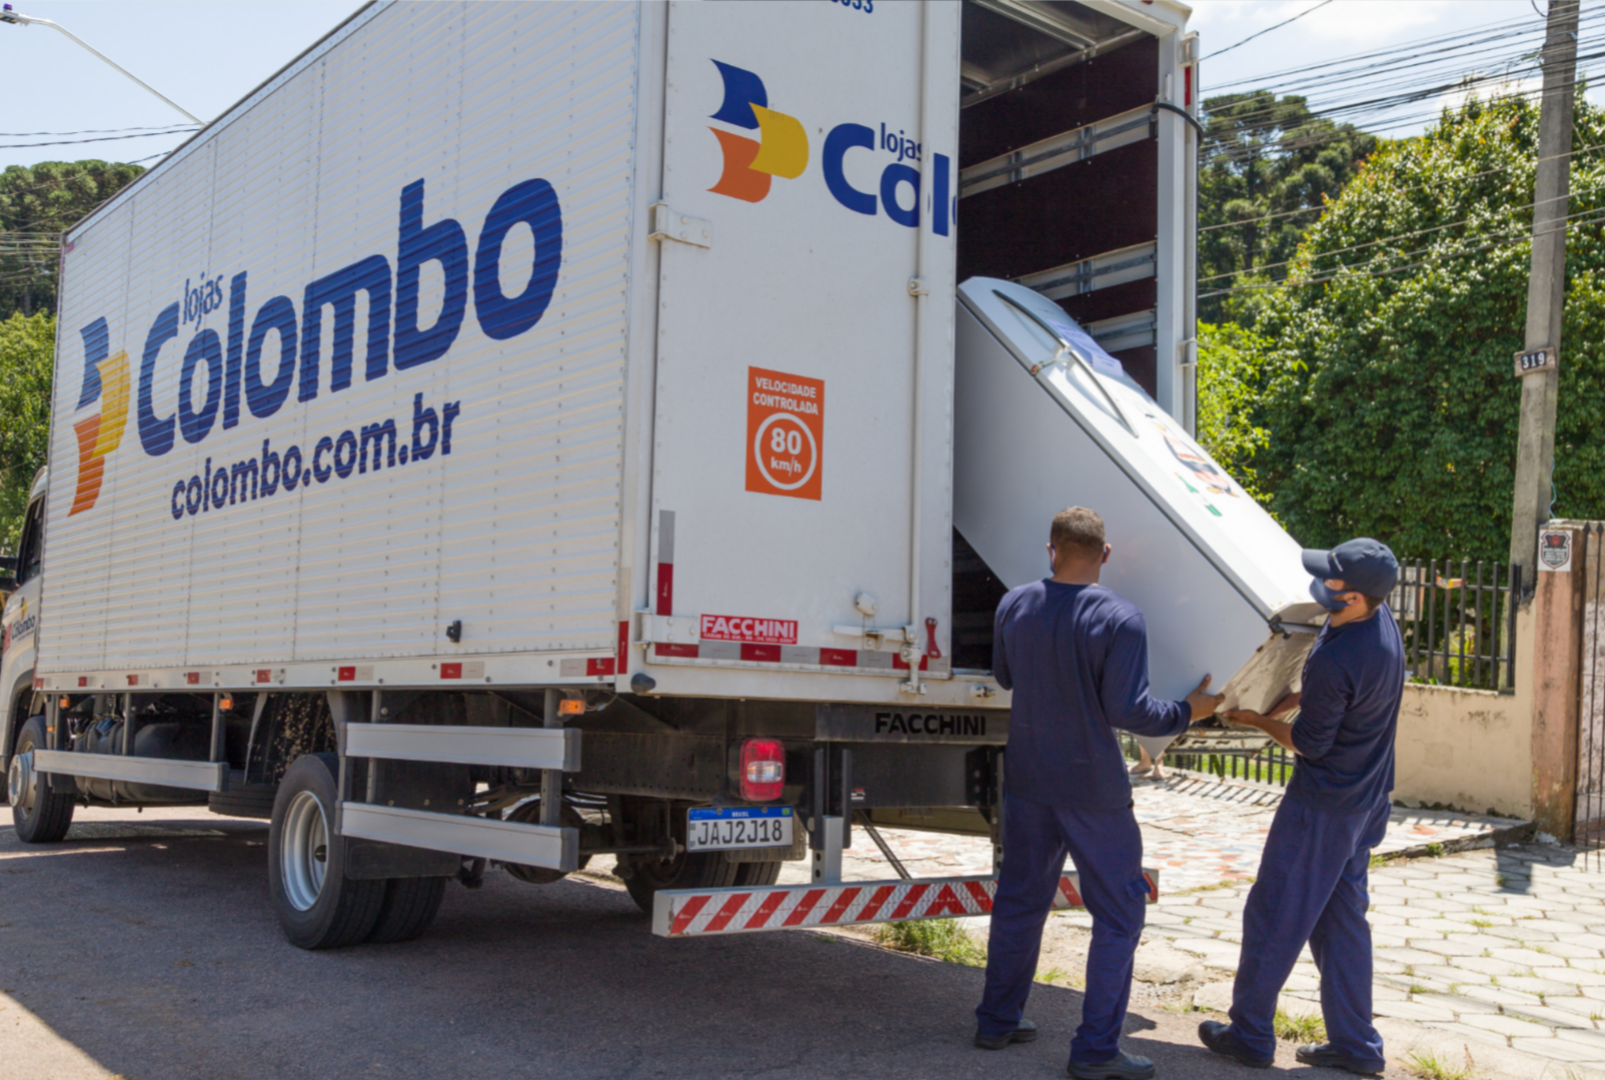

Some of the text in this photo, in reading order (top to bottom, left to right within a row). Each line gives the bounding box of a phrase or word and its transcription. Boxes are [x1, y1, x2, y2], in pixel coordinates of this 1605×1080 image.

[822, 122, 957, 237] Col
[183, 271, 224, 332] lojas
[137, 177, 563, 457] Colombo
[1522, 351, 1545, 369] 319
[755, 376, 817, 399] VELOCIDADE
[753, 392, 819, 415] CONTROLADA
[770, 427, 802, 455] 80
[171, 392, 461, 520] colombo.com.br
[770, 456, 802, 478] km/h
[702, 616, 795, 639] FACCHINI
[875, 712, 986, 736] FACCHINI
[697, 819, 783, 845] JAJ2J18
